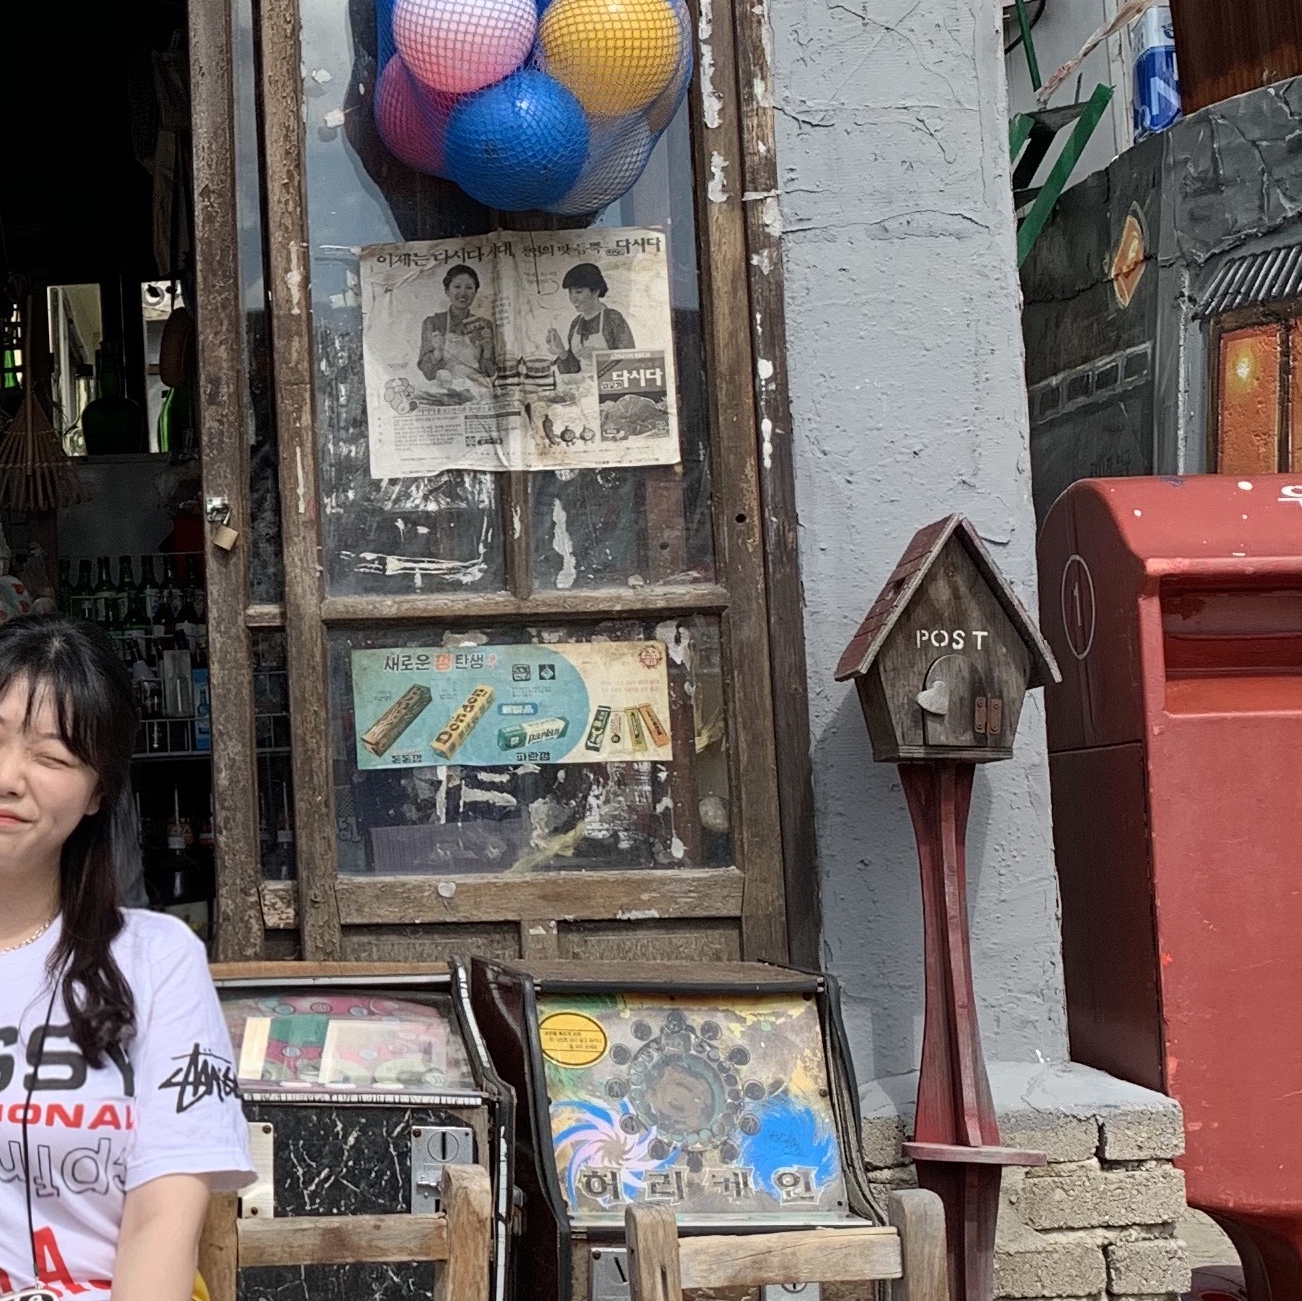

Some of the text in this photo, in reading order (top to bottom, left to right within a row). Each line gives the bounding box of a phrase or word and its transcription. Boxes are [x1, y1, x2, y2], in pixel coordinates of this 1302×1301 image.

[376, 250, 430, 268] 이제는
[433, 245, 486, 265] 다시다
[616, 236, 662, 255] 다시다
[612, 367, 663, 388] 다시다
[915, 629, 989, 652] POST
[383, 653, 431, 672] 새로운
[516, 751, 551, 762] 파란껌
